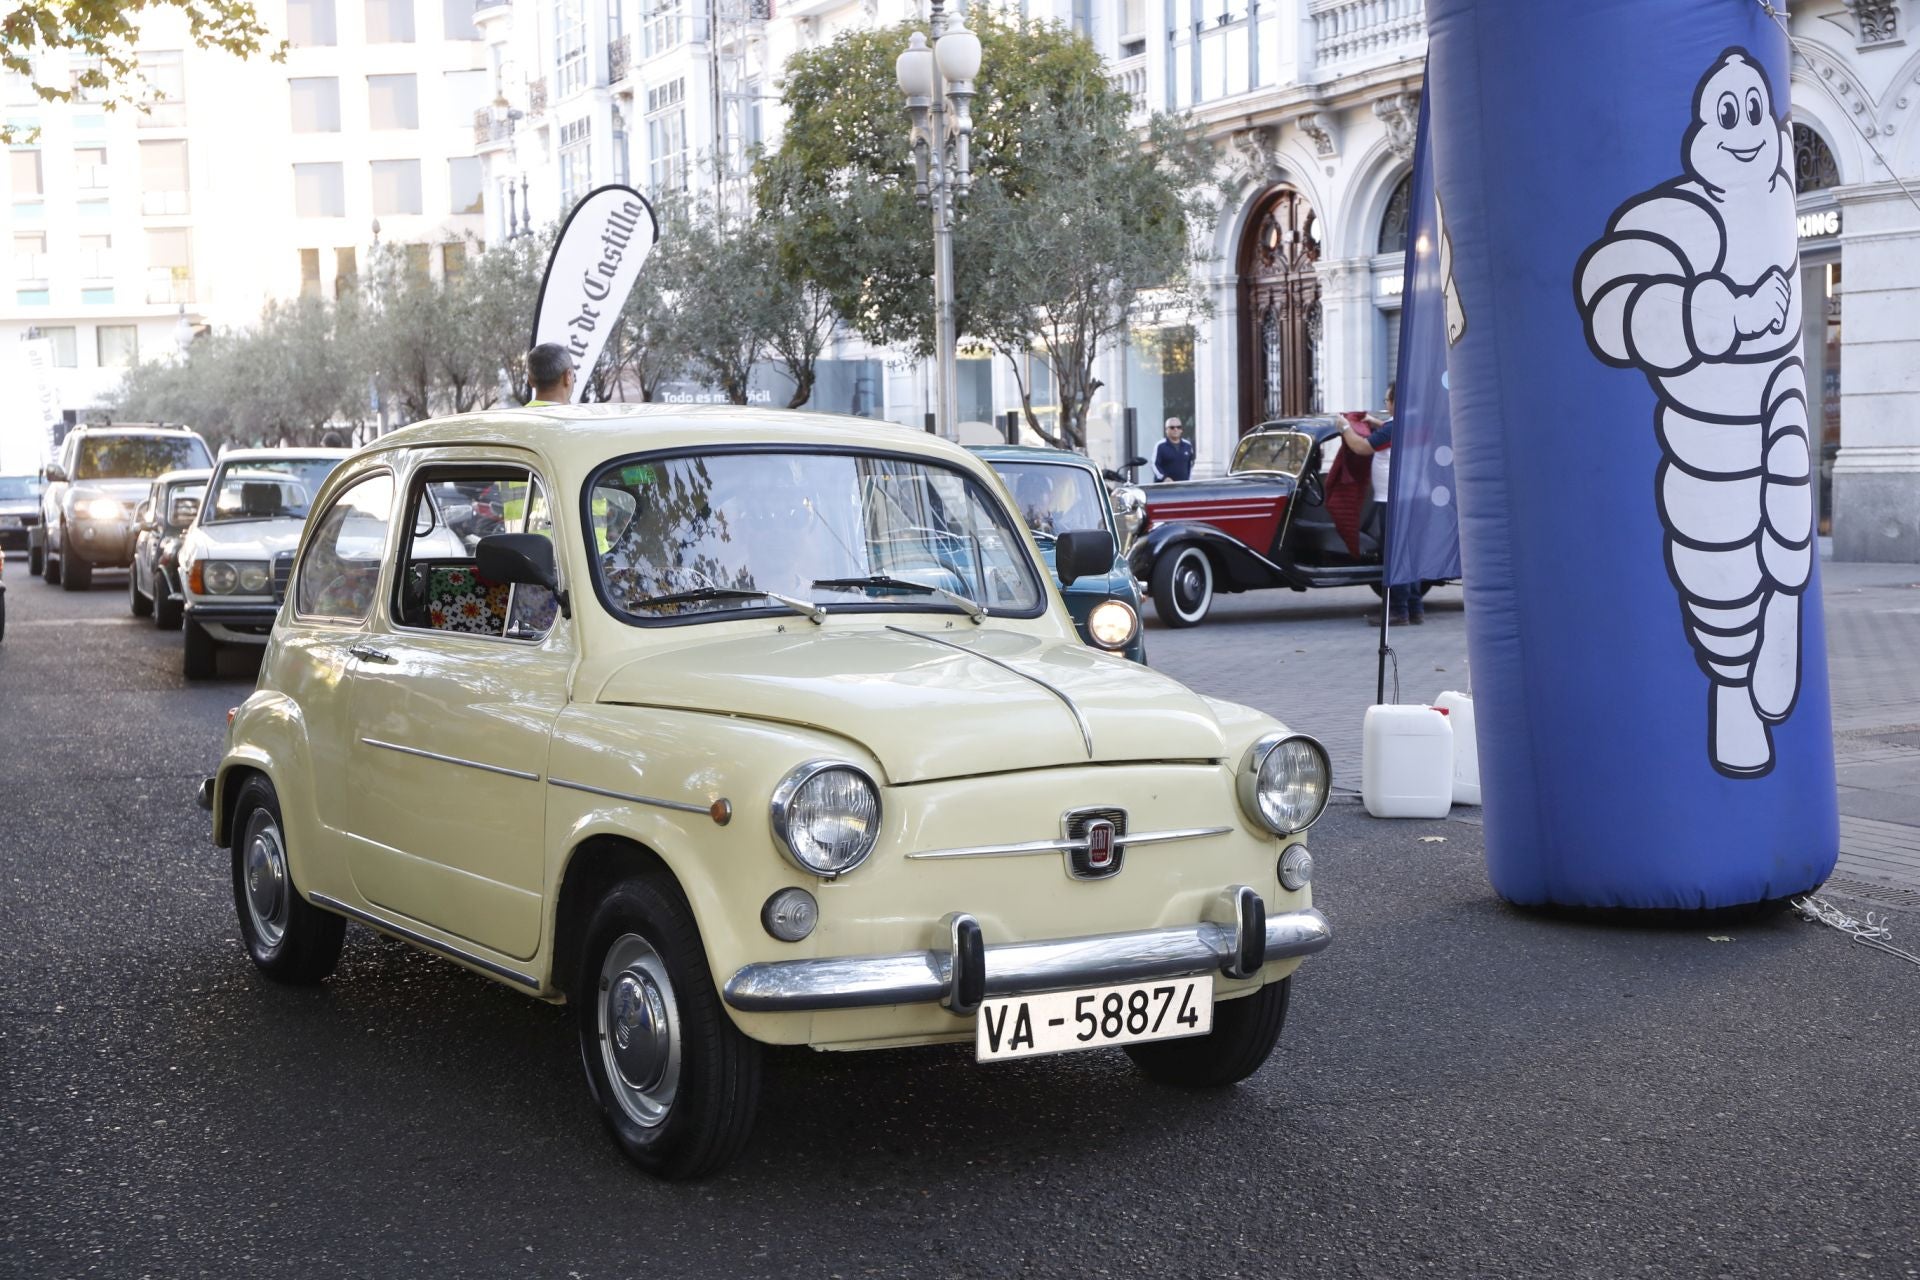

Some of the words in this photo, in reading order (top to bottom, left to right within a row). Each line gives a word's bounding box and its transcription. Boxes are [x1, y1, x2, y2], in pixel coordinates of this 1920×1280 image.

[1796, 211, 1839, 238] KING
[582, 201, 643, 301] Castilla
[568, 302, 600, 332] de
[662, 392, 694, 403] Todo
[695, 393, 709, 403] es
